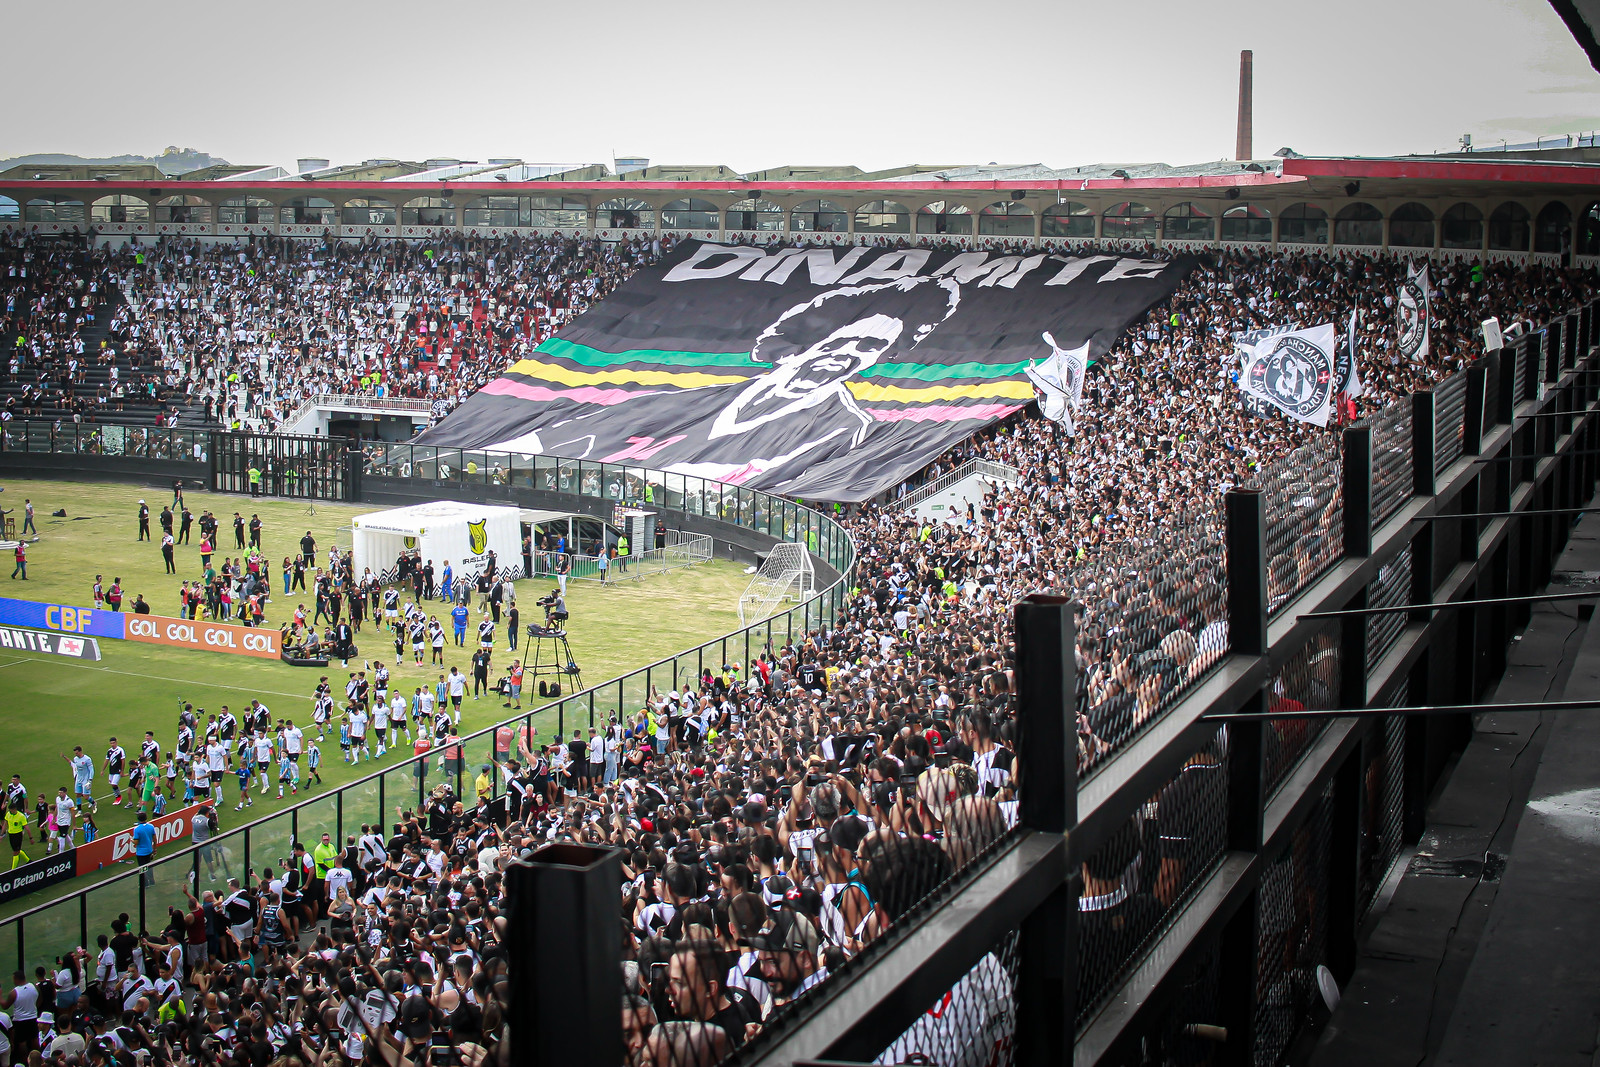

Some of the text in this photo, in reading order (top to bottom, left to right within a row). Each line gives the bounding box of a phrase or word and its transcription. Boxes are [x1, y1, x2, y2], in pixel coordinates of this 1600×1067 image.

[662, 246, 1170, 289] DINAMITE
[45, 606, 92, 632] CBF
[0, 629, 52, 653] ANTE
[129, 618, 276, 653] GOL GOL GOL GOL
[803, 673, 814, 684] 10
[112, 818, 184, 861] Beano
[13, 871, 45, 890] Betano
[46, 860, 72, 878] 2024
